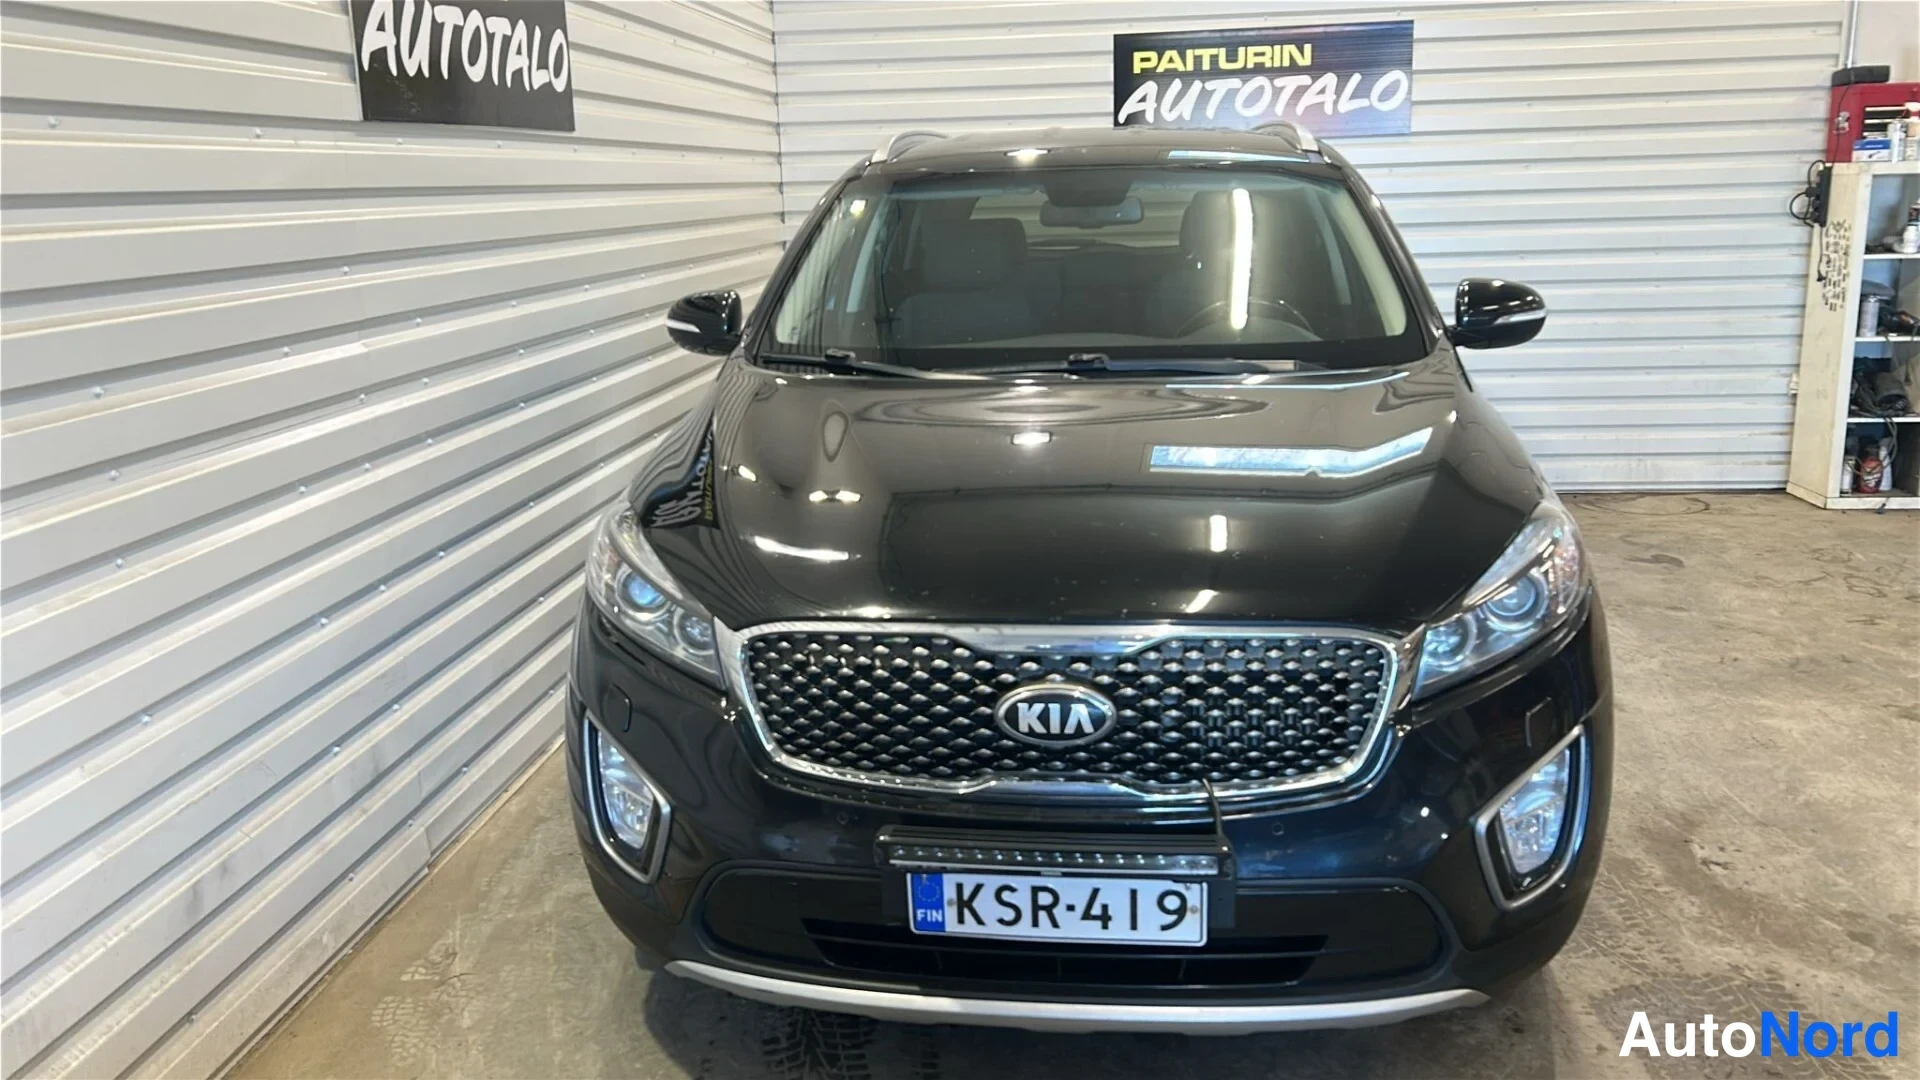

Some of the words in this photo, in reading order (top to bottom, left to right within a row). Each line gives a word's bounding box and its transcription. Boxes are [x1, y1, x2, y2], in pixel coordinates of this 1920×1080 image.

[361, 0, 569, 93] AUTOTALO
[1133, 43, 1312, 75] PAITURIN
[1117, 69, 1409, 124] AUTOTALO
[1016, 702, 1095, 735] KIA
[916, 909, 943, 924] FIN
[955, 882, 1189, 932] KSR-419
